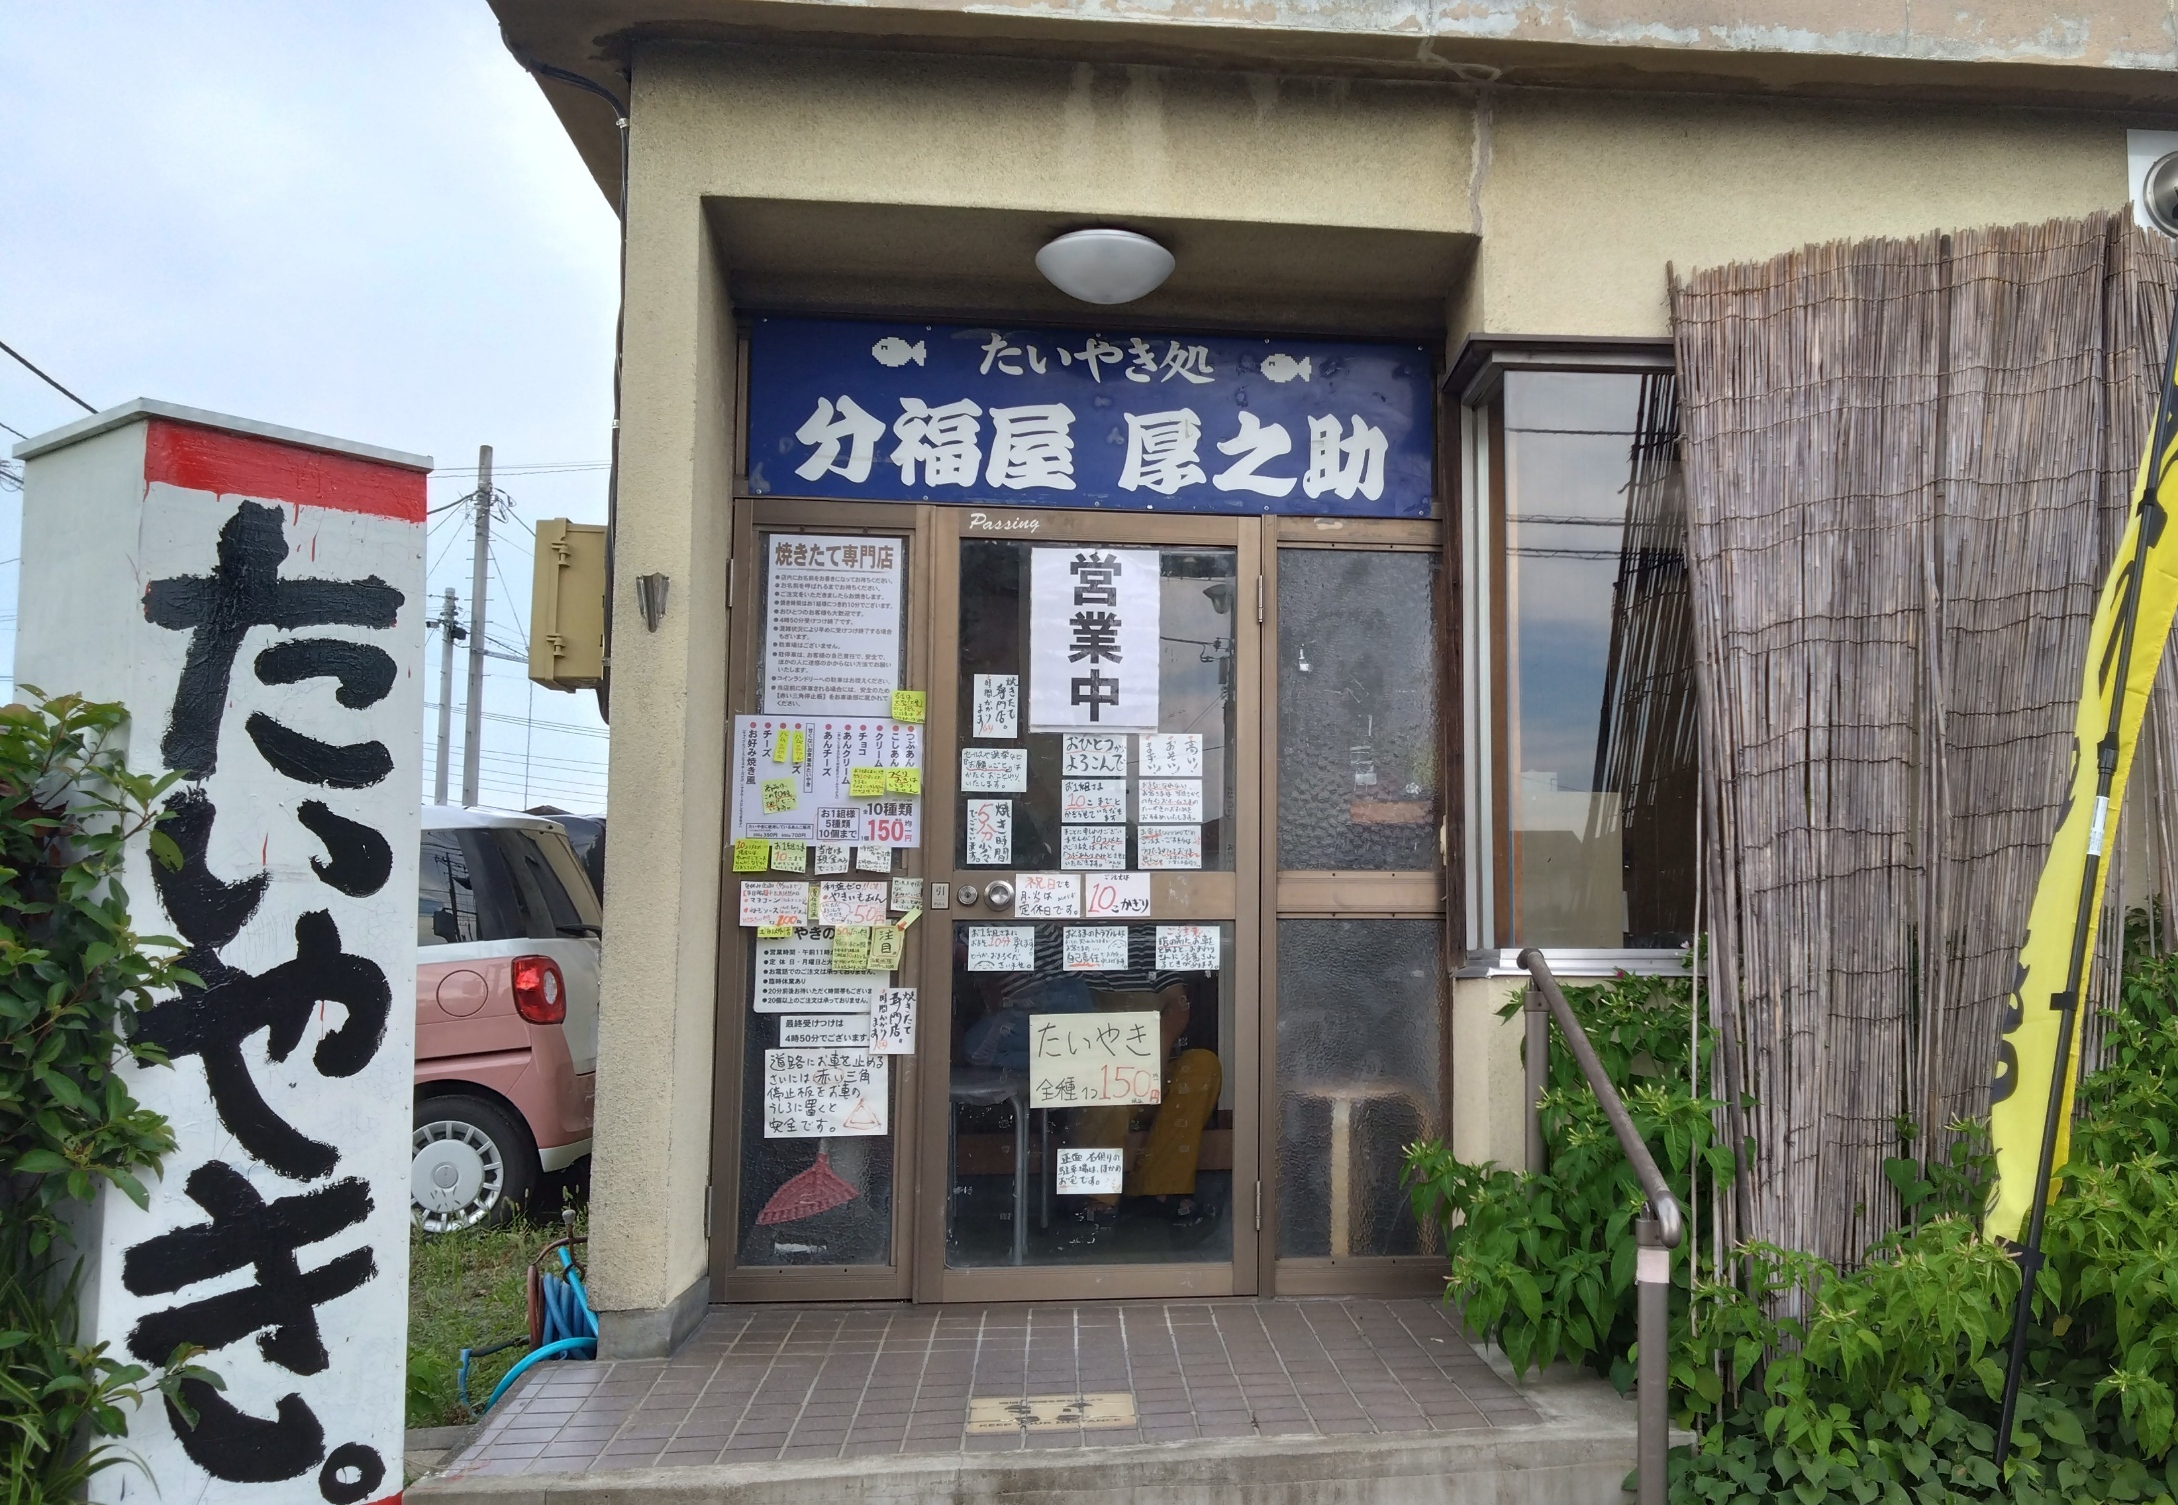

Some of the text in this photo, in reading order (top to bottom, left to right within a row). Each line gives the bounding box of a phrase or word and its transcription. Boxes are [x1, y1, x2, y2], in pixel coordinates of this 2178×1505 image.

[980, 332, 1215, 383] たいやき処
[795, 394, 1389, 501] 分福屋 厚之助
[969, 512, 1040, 534] Passing
[775, 542, 894, 570] 焼きたて専門店
[1068, 552, 1123, 722] 営業中
[762, 730, 772, 757] チーズ
[822, 732, 833, 777] あんチーズ
[858, 732, 867, 756] チョコ
[874, 733, 883, 767] クリーム
[890, 733, 900, 767] こしあん
[905, 733, 915, 767] つぶあん
[746, 729, 757, 784] お好み焼き風
[841, 732, 852, 785] あんクリーム
[1066, 754, 1126, 771] よろこんで
[821, 809, 856, 819] お1組様
[862, 803, 913, 816] 全10種類
[819, 829, 857, 839] 10個まで
[825, 819, 851, 829] 5種類
[868, 819, 903, 841] 150
[994, 802, 1010, 862] 焼き時間
[935, 886, 945, 896] 引
[1025, 876, 1070, 890] 祝日でも
[1019, 904, 1078, 916] 定休日です。
[123, 498, 405, 1504] たいやき。
[785, 1019, 844, 1028] 最終受けつけは
[1038, 1022, 1151, 1057] たいやき
[769, 1051, 884, 1071] 道路にお車を止める
[767, 1086, 861, 1099] 停止板をお車の
[1036, 1077, 1078, 1101] 全種
[768, 1098, 838, 1116] うしろに置くと
[768, 1117, 836, 1134] 安全です。
